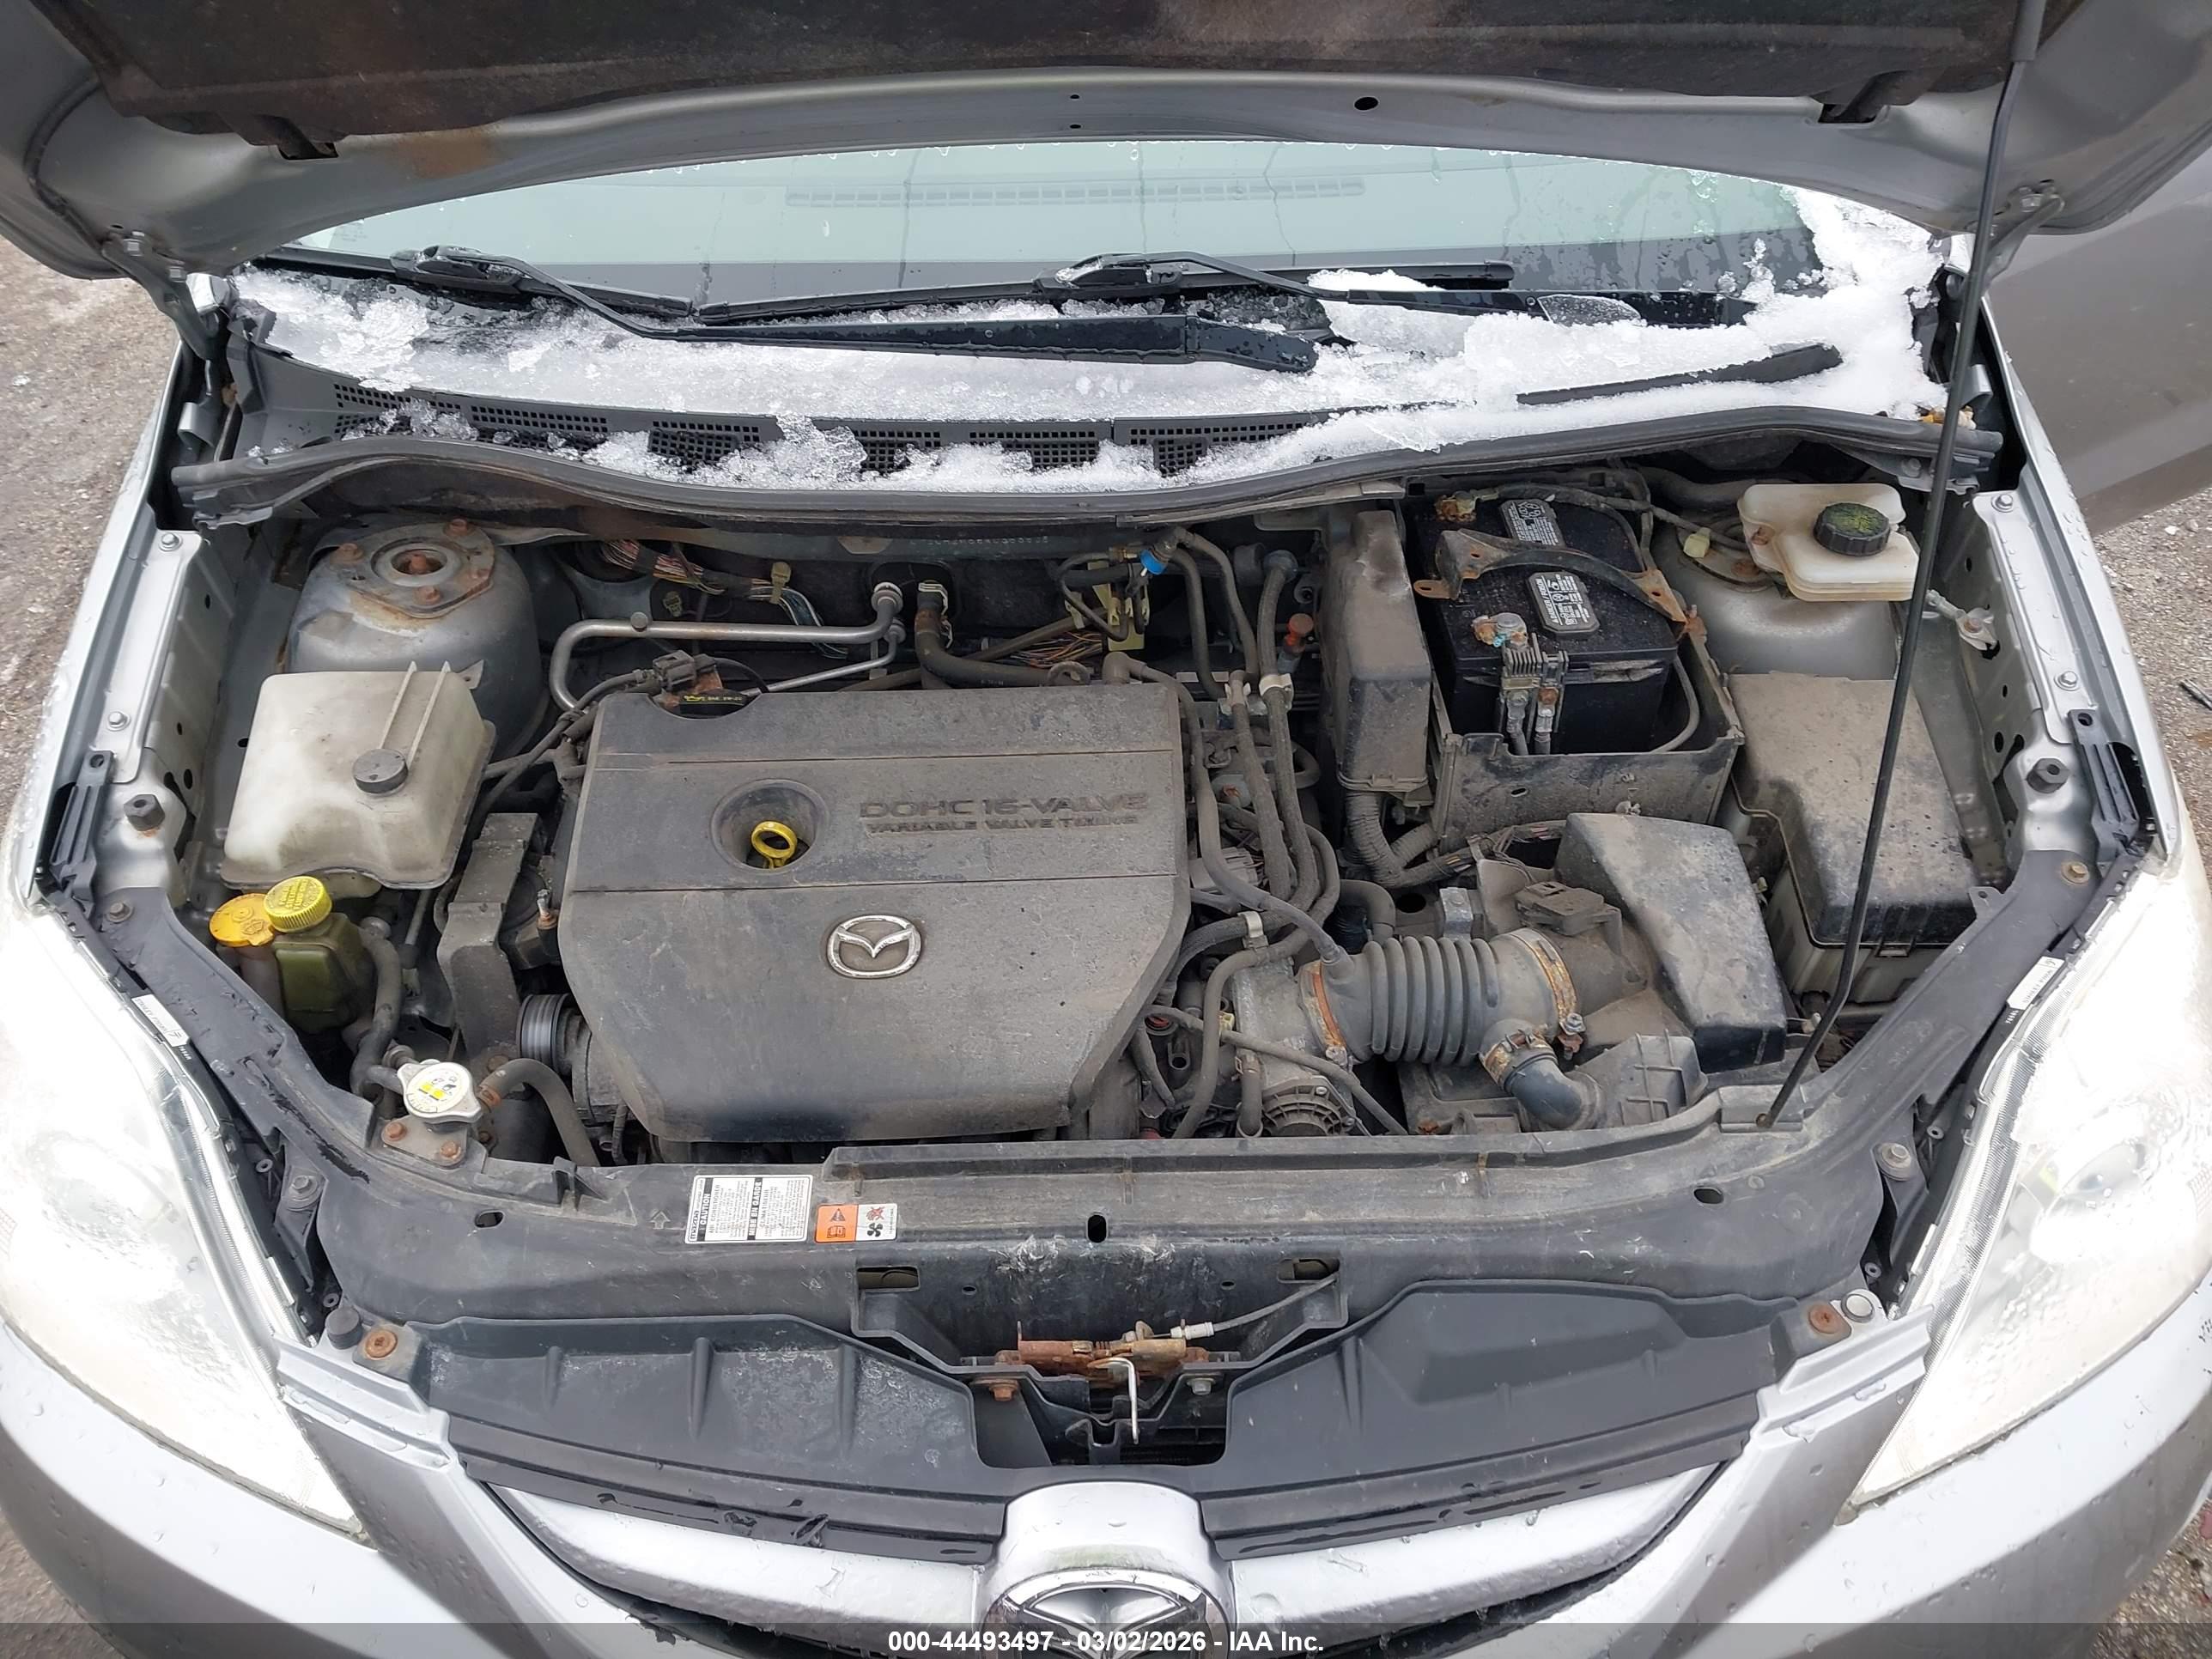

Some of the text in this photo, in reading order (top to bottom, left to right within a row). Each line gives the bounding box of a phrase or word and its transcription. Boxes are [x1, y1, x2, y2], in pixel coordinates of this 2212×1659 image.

[860, 793, 1149, 817] DOHC 16-VALVE
[866, 820, 978, 834] VARIABLE
[984, 818, 1055, 830] VALVE
[700, 1193, 711, 1225] CAUTION
[711, 1184, 720, 1222] CONDITIONER
[748, 1181, 762, 1237] MISE EN GARDE
